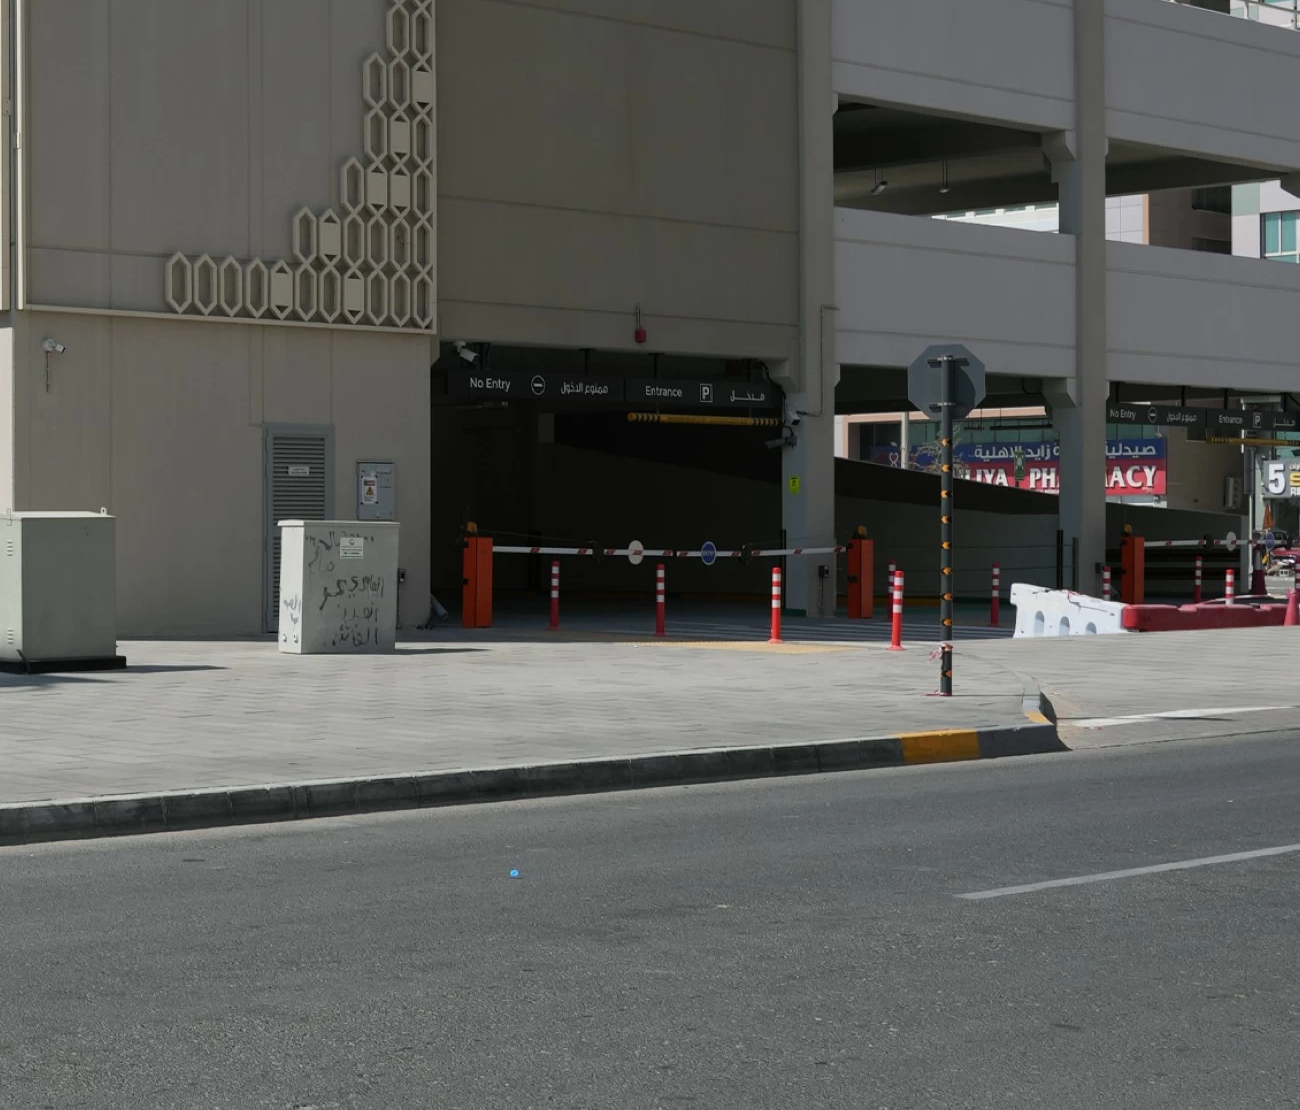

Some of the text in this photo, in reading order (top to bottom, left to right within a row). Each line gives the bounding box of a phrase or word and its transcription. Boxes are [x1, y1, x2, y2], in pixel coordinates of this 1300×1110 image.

[469, 377, 511, 393] No Entry
[560, 381, 609, 396] ممنوع الدخول
[645, 385, 683, 398] Entrance
[1109, 408, 1137, 421] No Entry
[1218, 414, 1243, 425] Entrance
[1105, 441, 1157, 459] صيدلي
[1269, 463, 1286, 494] 5
